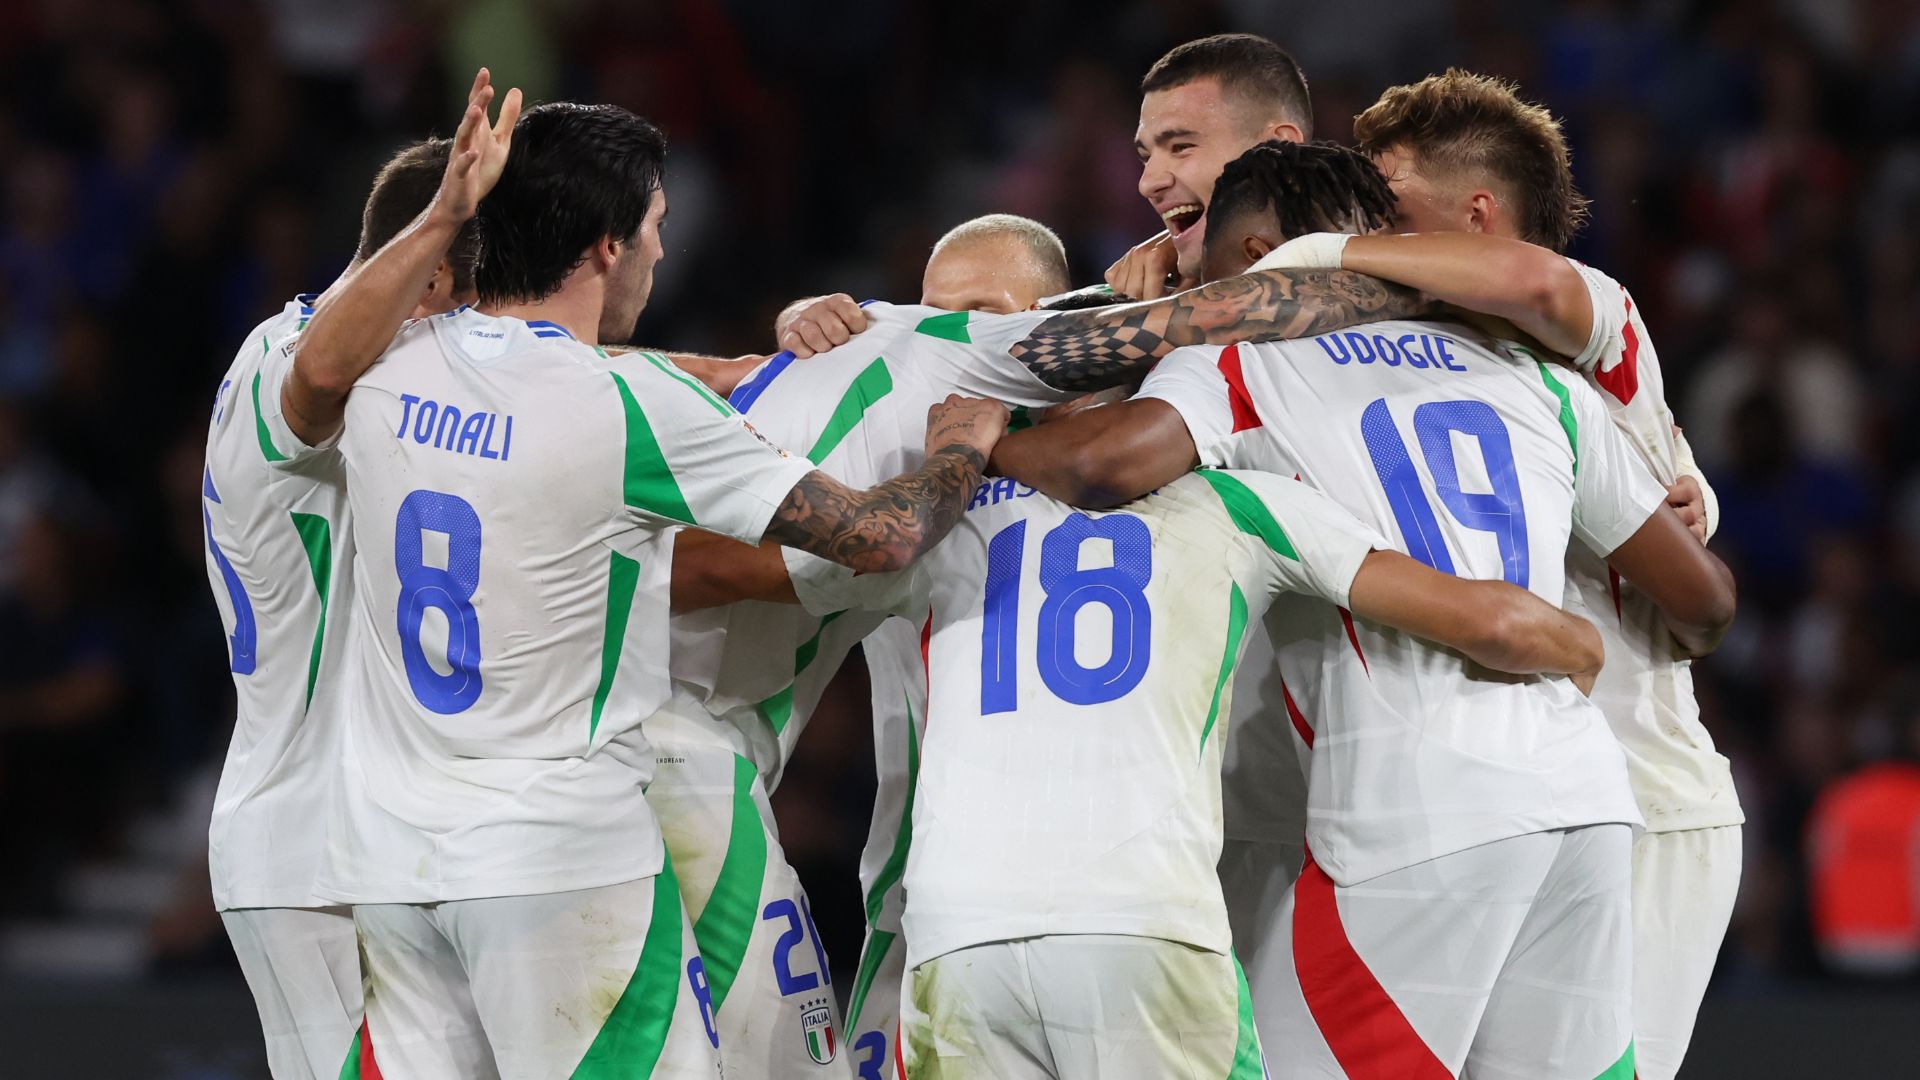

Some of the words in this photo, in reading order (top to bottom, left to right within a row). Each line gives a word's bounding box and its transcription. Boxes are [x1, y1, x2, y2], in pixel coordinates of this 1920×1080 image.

[1315, 332, 1467, 371] UDOGIE
[397, 393, 513, 461] TONALI
[1361, 398, 1530, 590] 19
[395, 489, 482, 715] 8
[981, 512, 1152, 716] 18
[687, 956, 719, 1049] 8
[804, 1011, 829, 1028] ITALIA
